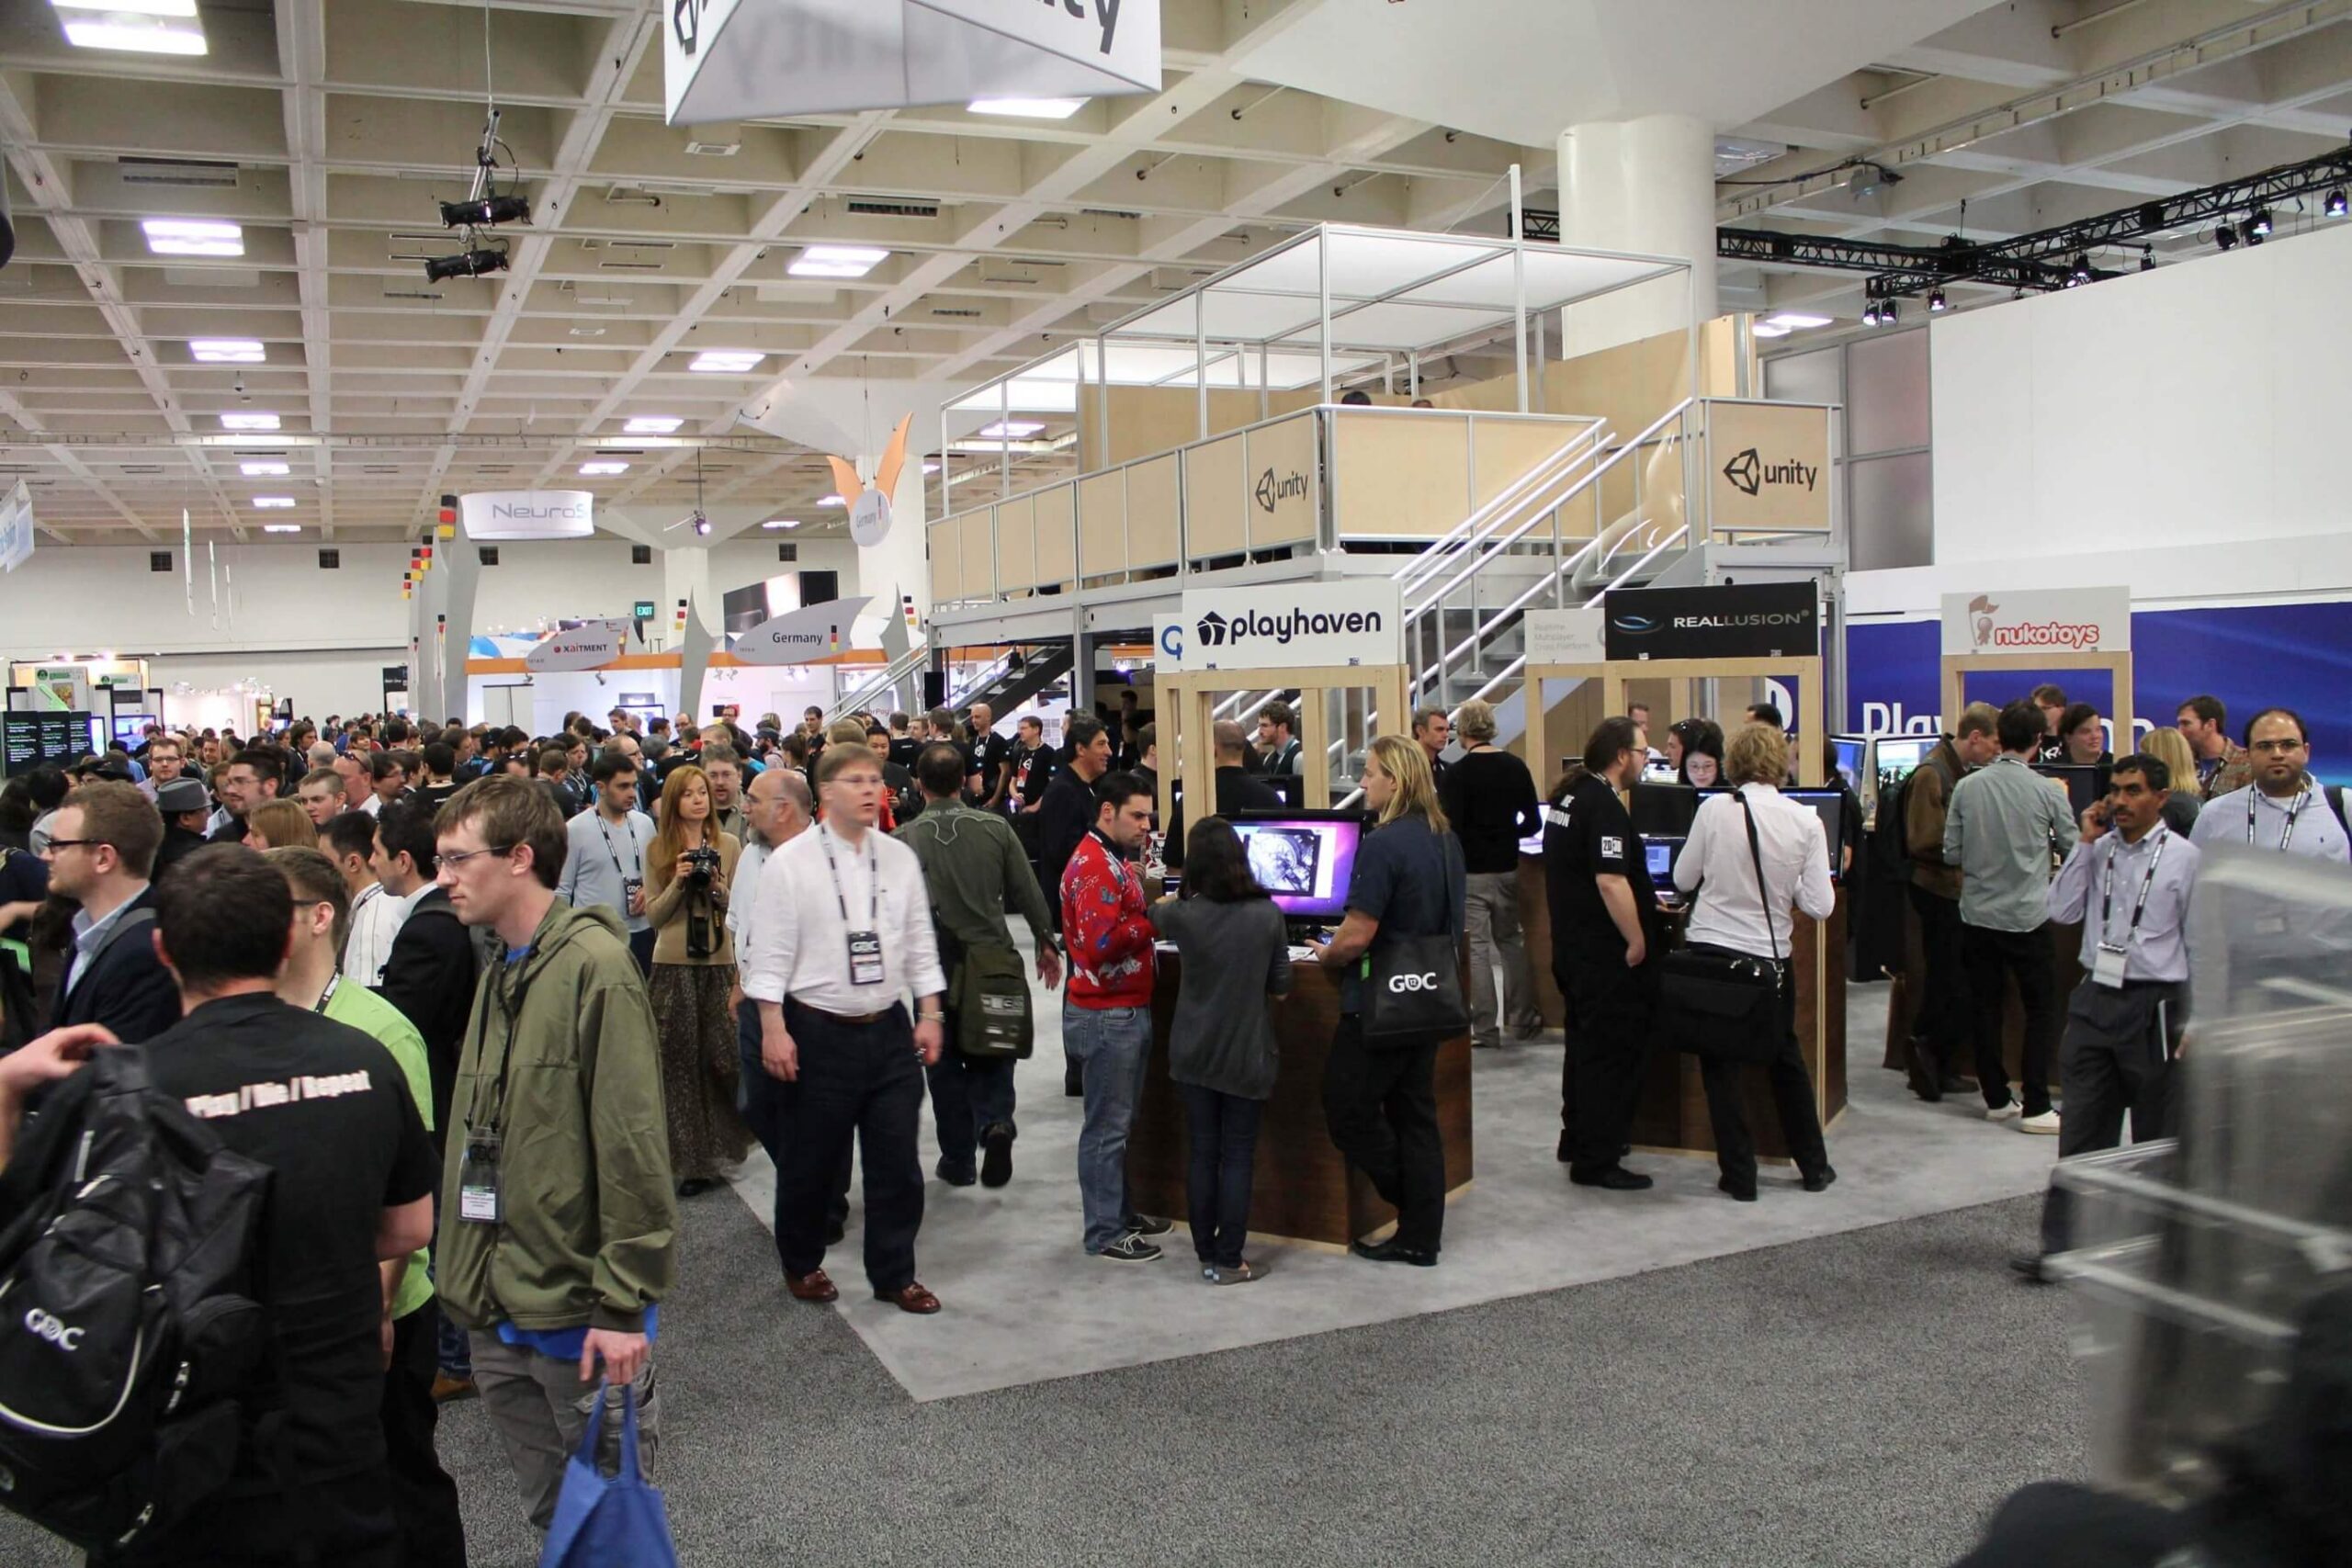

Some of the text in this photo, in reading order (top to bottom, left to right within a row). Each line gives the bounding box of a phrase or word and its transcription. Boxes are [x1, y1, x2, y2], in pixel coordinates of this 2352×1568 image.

[1276, 470, 1308, 501] unity
[1764, 457, 1818, 492] unity
[636, 605, 654, 616] EXIT
[772, 632, 823, 646] Germany
[1230, 607, 1381, 646] playhaven
[1994, 622, 2099, 649] nukotoys
[1388, 971, 1438, 993] GDC
[25, 1307, 86, 1351] GDC
